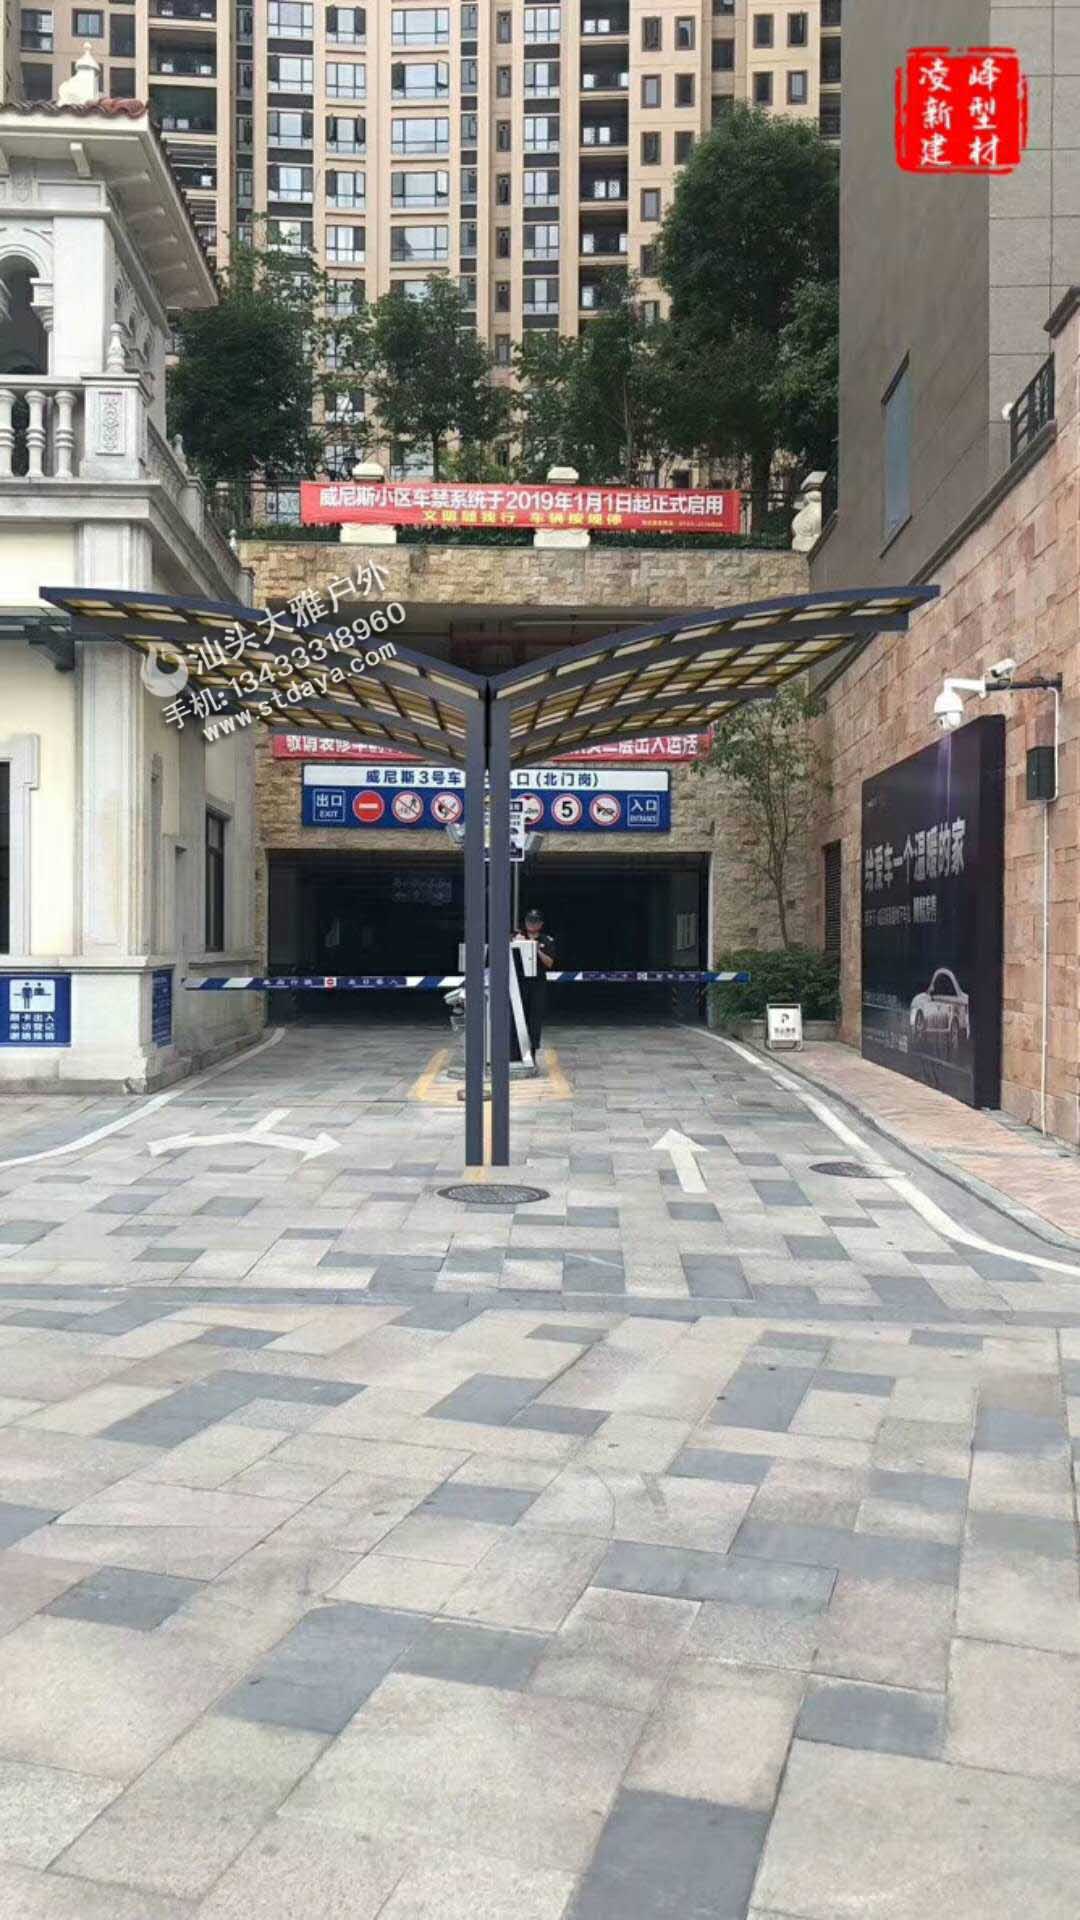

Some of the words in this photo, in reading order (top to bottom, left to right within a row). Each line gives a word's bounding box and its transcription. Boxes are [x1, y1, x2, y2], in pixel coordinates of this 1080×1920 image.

[319, 485, 724, 516] 威尼斯小区车禁系统于2019年1月1日起正式启用
[365, 770, 462, 785] 威尼斯3号车
[510, 771, 600, 788] 口（北门岗）
[316, 793, 342, 807] 出口
[561, 801, 573, 818] 5
[631, 798, 657, 811] 入口
[319, 810, 339, 818] EXIT
